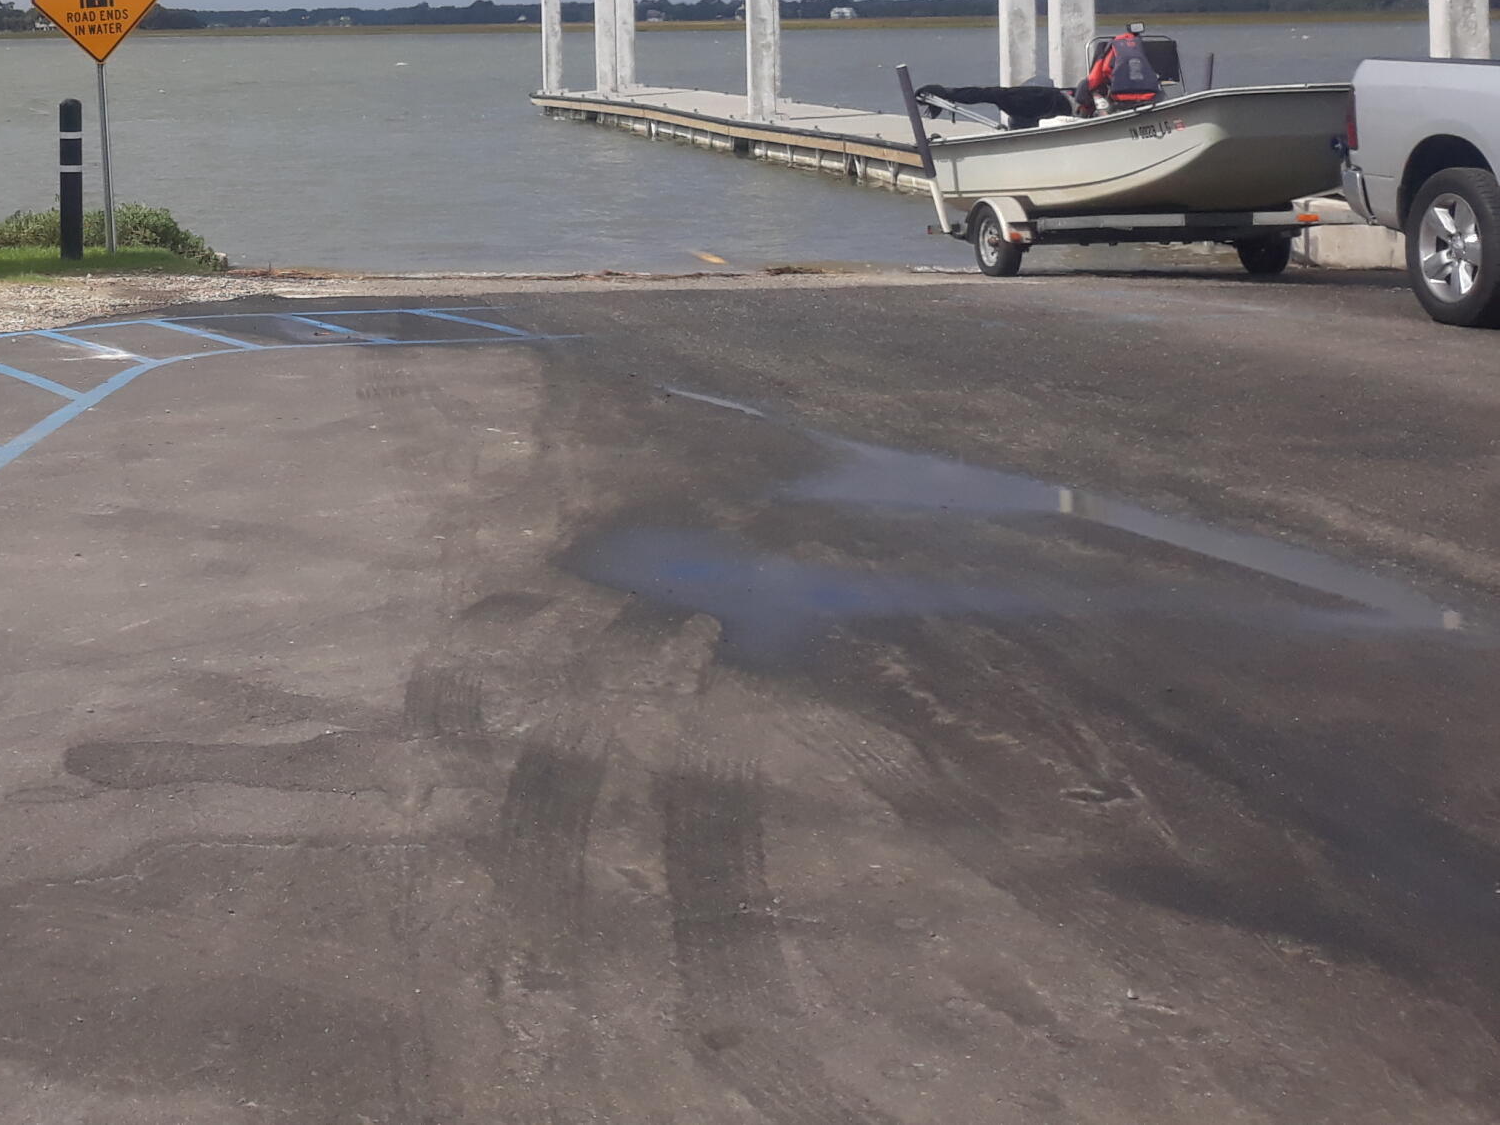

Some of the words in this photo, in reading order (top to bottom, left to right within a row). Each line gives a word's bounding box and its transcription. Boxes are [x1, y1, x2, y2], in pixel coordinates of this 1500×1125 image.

[67, 11, 96, 23] ROAD
[100, 9, 129, 21] ENDS
[74, 25, 85, 35] IN
[88, 23, 122, 35] WATER
